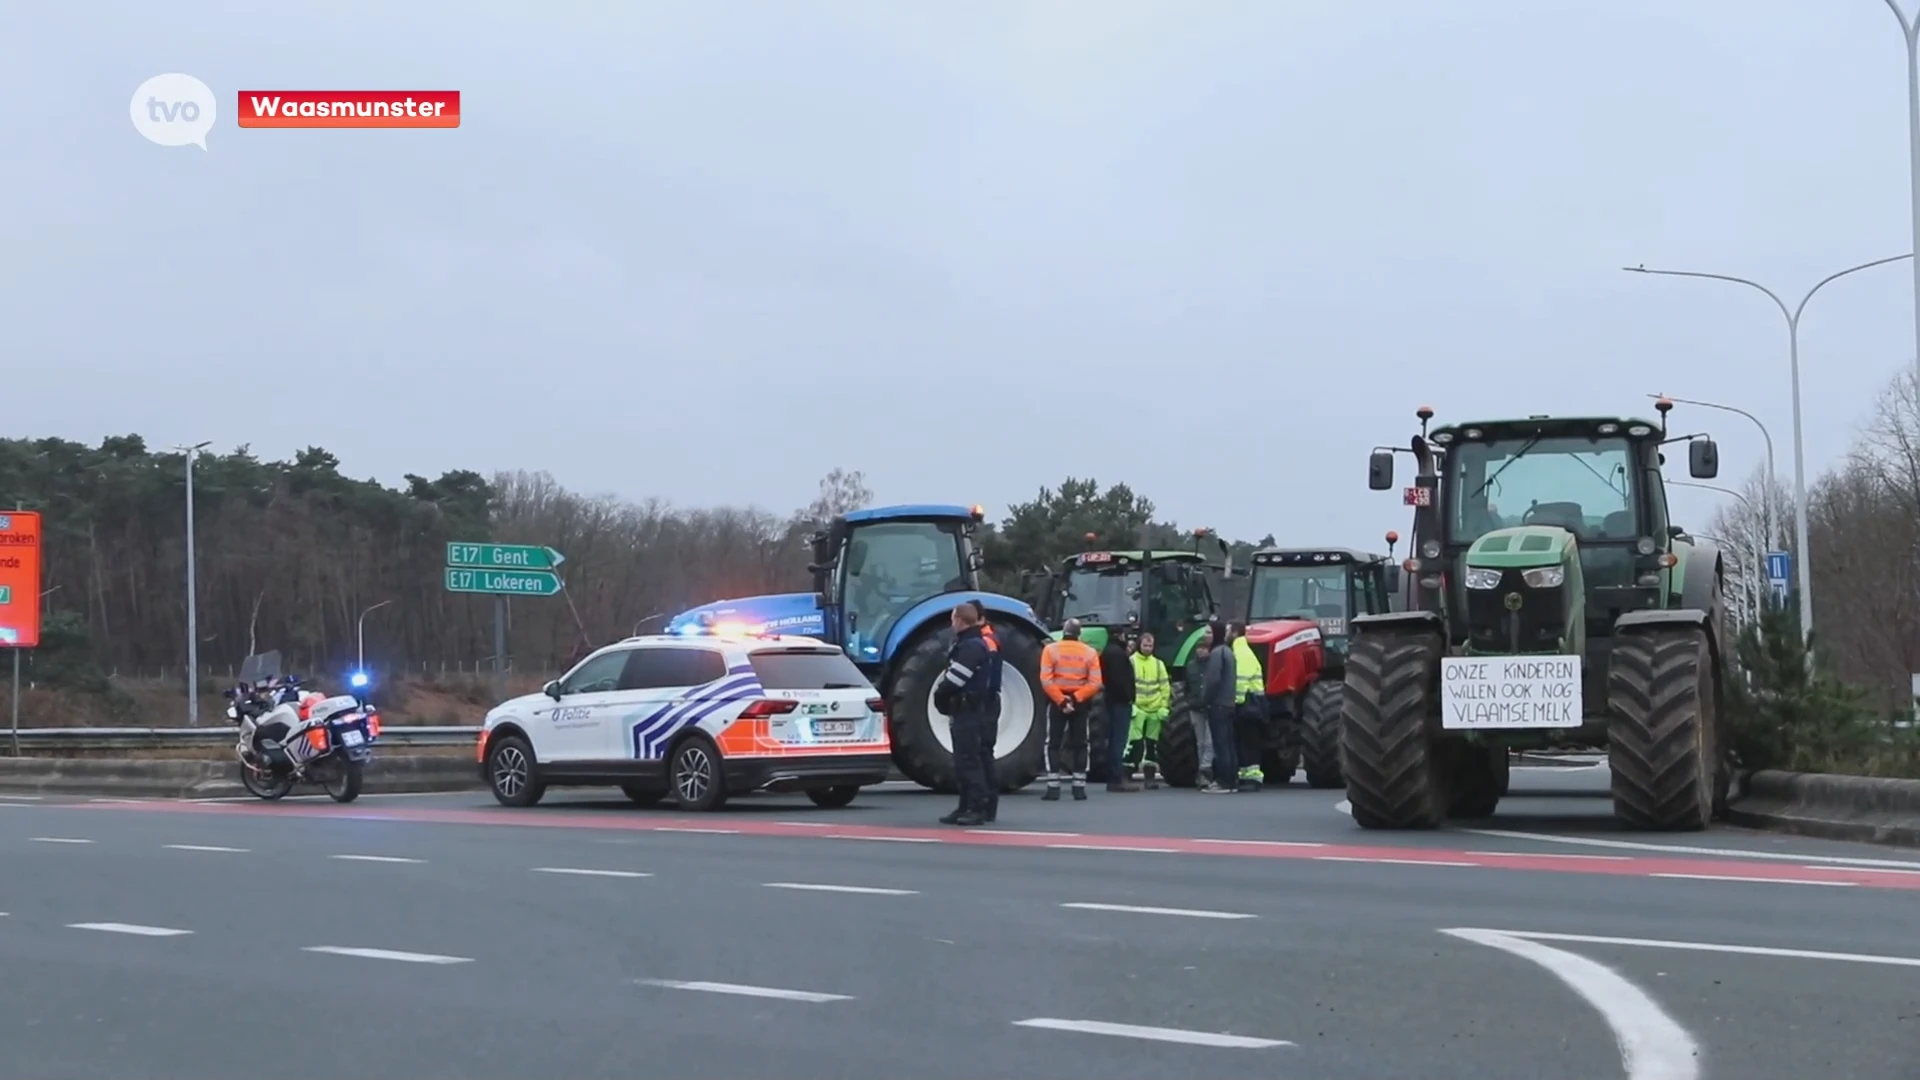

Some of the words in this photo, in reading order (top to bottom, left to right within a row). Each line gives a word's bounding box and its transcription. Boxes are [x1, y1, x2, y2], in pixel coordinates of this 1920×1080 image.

[451, 546, 478, 562] E17
[493, 548, 529, 565] Gent
[450, 571, 472, 588] E17
[485, 573, 542, 591] Lokeren
[1446, 664, 1489, 681] ONZE
[1501, 683, 1533, 698] OOK
[1541, 683, 1574, 698] NOG
[1452, 702, 1529, 723] VLAAMSE
[1533, 702, 1573, 721] MELK
